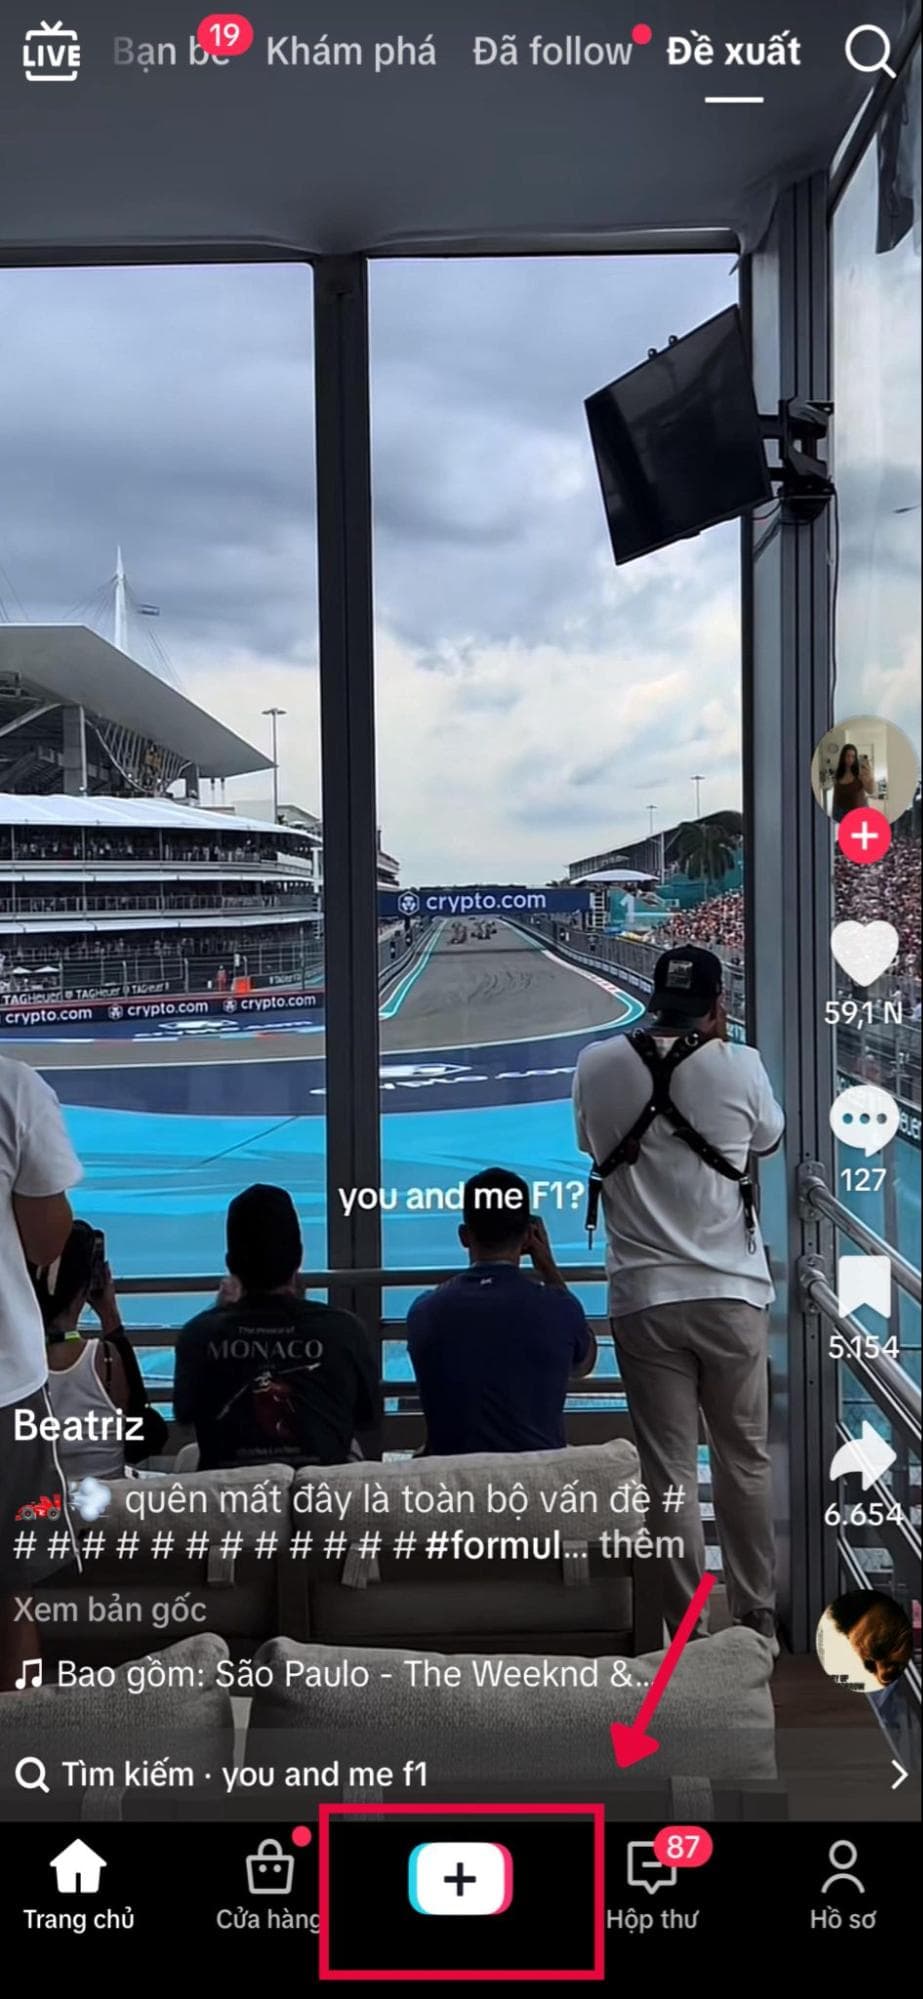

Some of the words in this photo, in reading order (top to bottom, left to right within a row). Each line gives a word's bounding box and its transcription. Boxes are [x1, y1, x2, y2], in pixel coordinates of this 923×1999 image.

[426, 891, 547, 914] crypto.com
[127, 1001, 209, 1017] crypto.com
[240, 995, 317, 1011] crypto.com
[5, 1008, 93, 1025] crypto.com
[207, 1339, 325, 1361] MONACO
